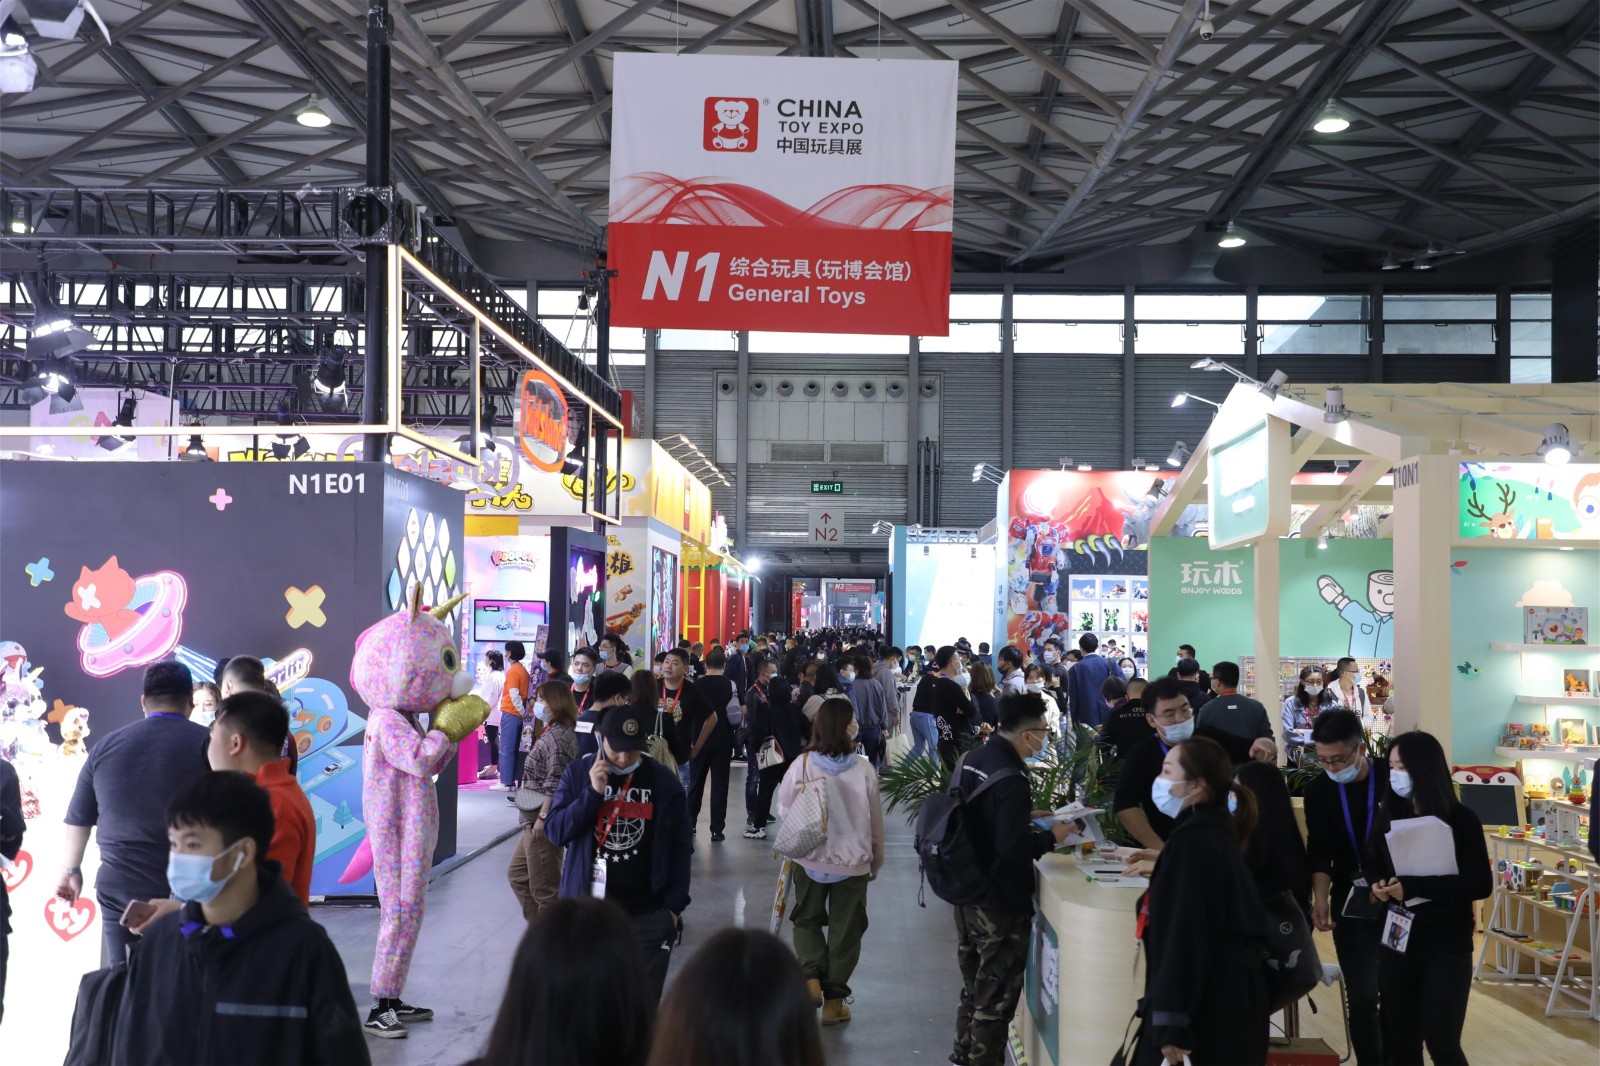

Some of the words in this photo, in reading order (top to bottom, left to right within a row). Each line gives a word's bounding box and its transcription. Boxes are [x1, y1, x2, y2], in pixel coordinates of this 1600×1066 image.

[777, 98, 863, 119] CHINA
[778, 120, 811, 133] TOY
[819, 121, 864, 135] EXPO
[777, 137, 863, 155] 中国玩具展
[641, 250, 721, 302] N1
[729, 257, 911, 282] 综合玩具(玩博会馆)
[728, 283, 810, 304] General
[817, 286, 866, 309] Toys
[289, 473, 365, 495] N1E01
[815, 527, 838, 542] N2
[607, 552, 633, 580] 雄
[1181, 560, 1242, 587] 玩木
[1181, 587, 1211, 595] ENJOY
[1213, 587, 1243, 595] WOODS
[48, 896, 90, 935] ty
